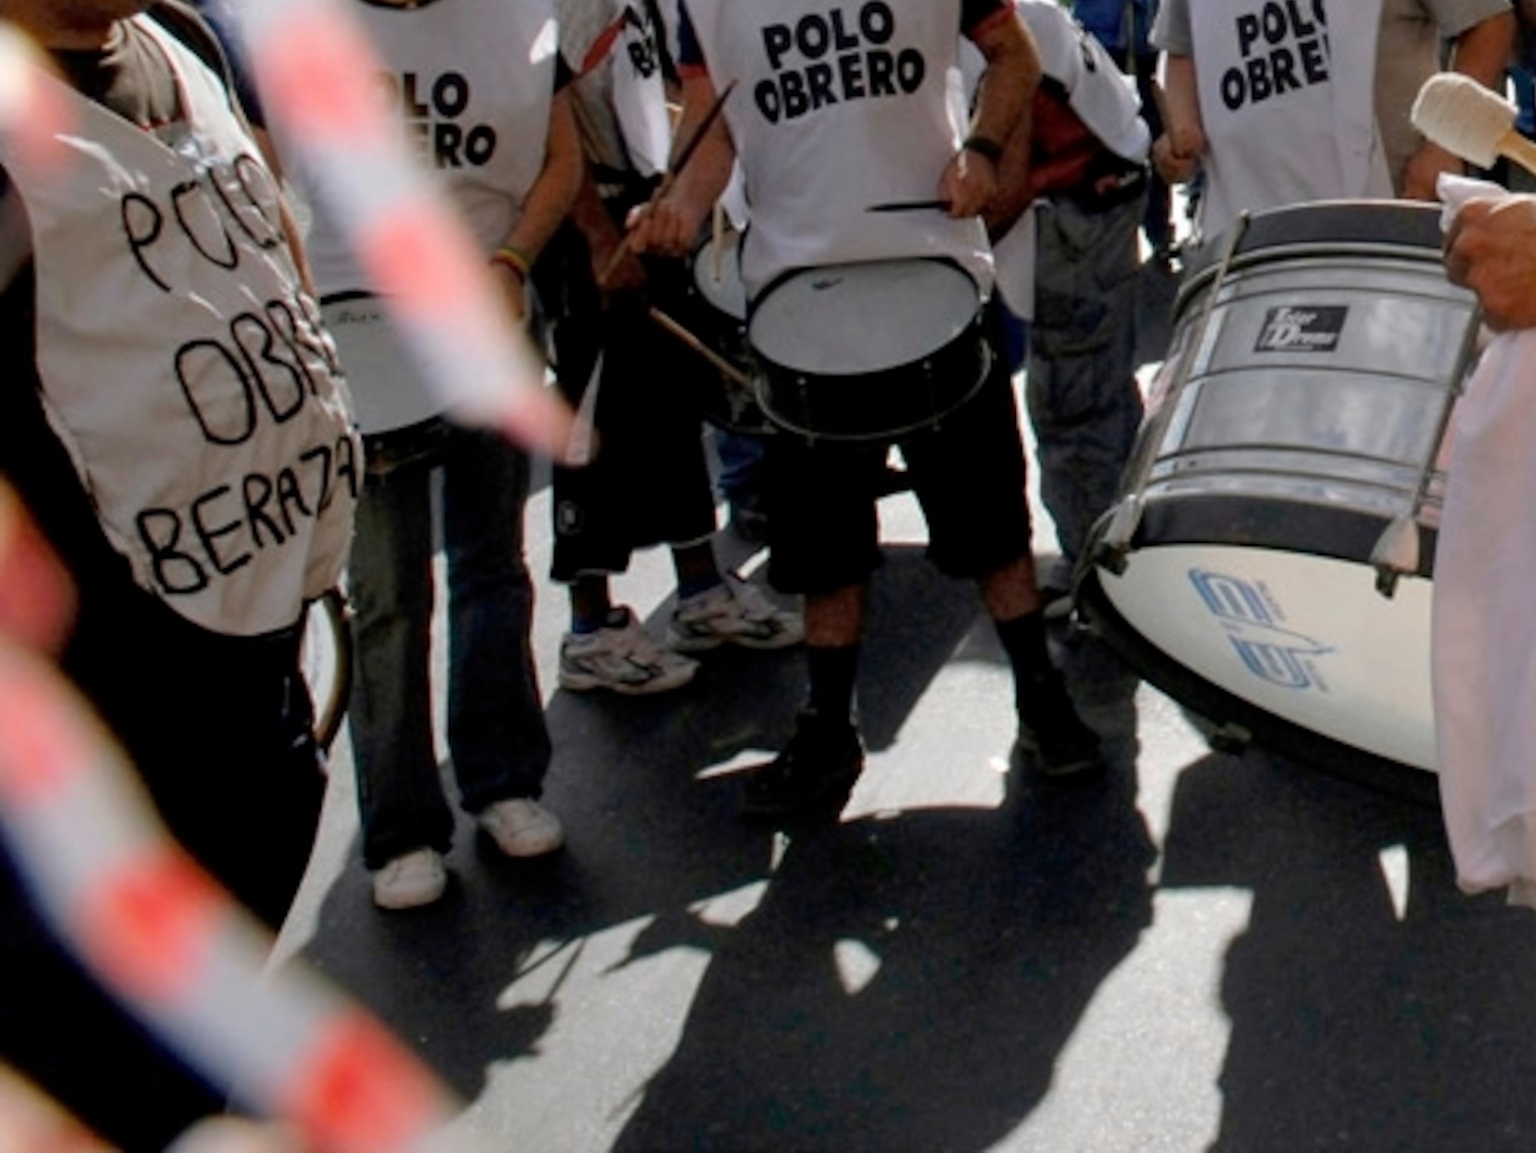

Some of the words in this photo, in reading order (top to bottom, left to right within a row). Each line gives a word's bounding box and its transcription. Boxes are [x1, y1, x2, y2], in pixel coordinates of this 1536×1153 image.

[761, 0, 895, 70] POLO
[1220, 35, 1332, 111] OBRE
[754, 47, 926, 126] OBRERO
[136, 435, 359, 596] BERAZA
